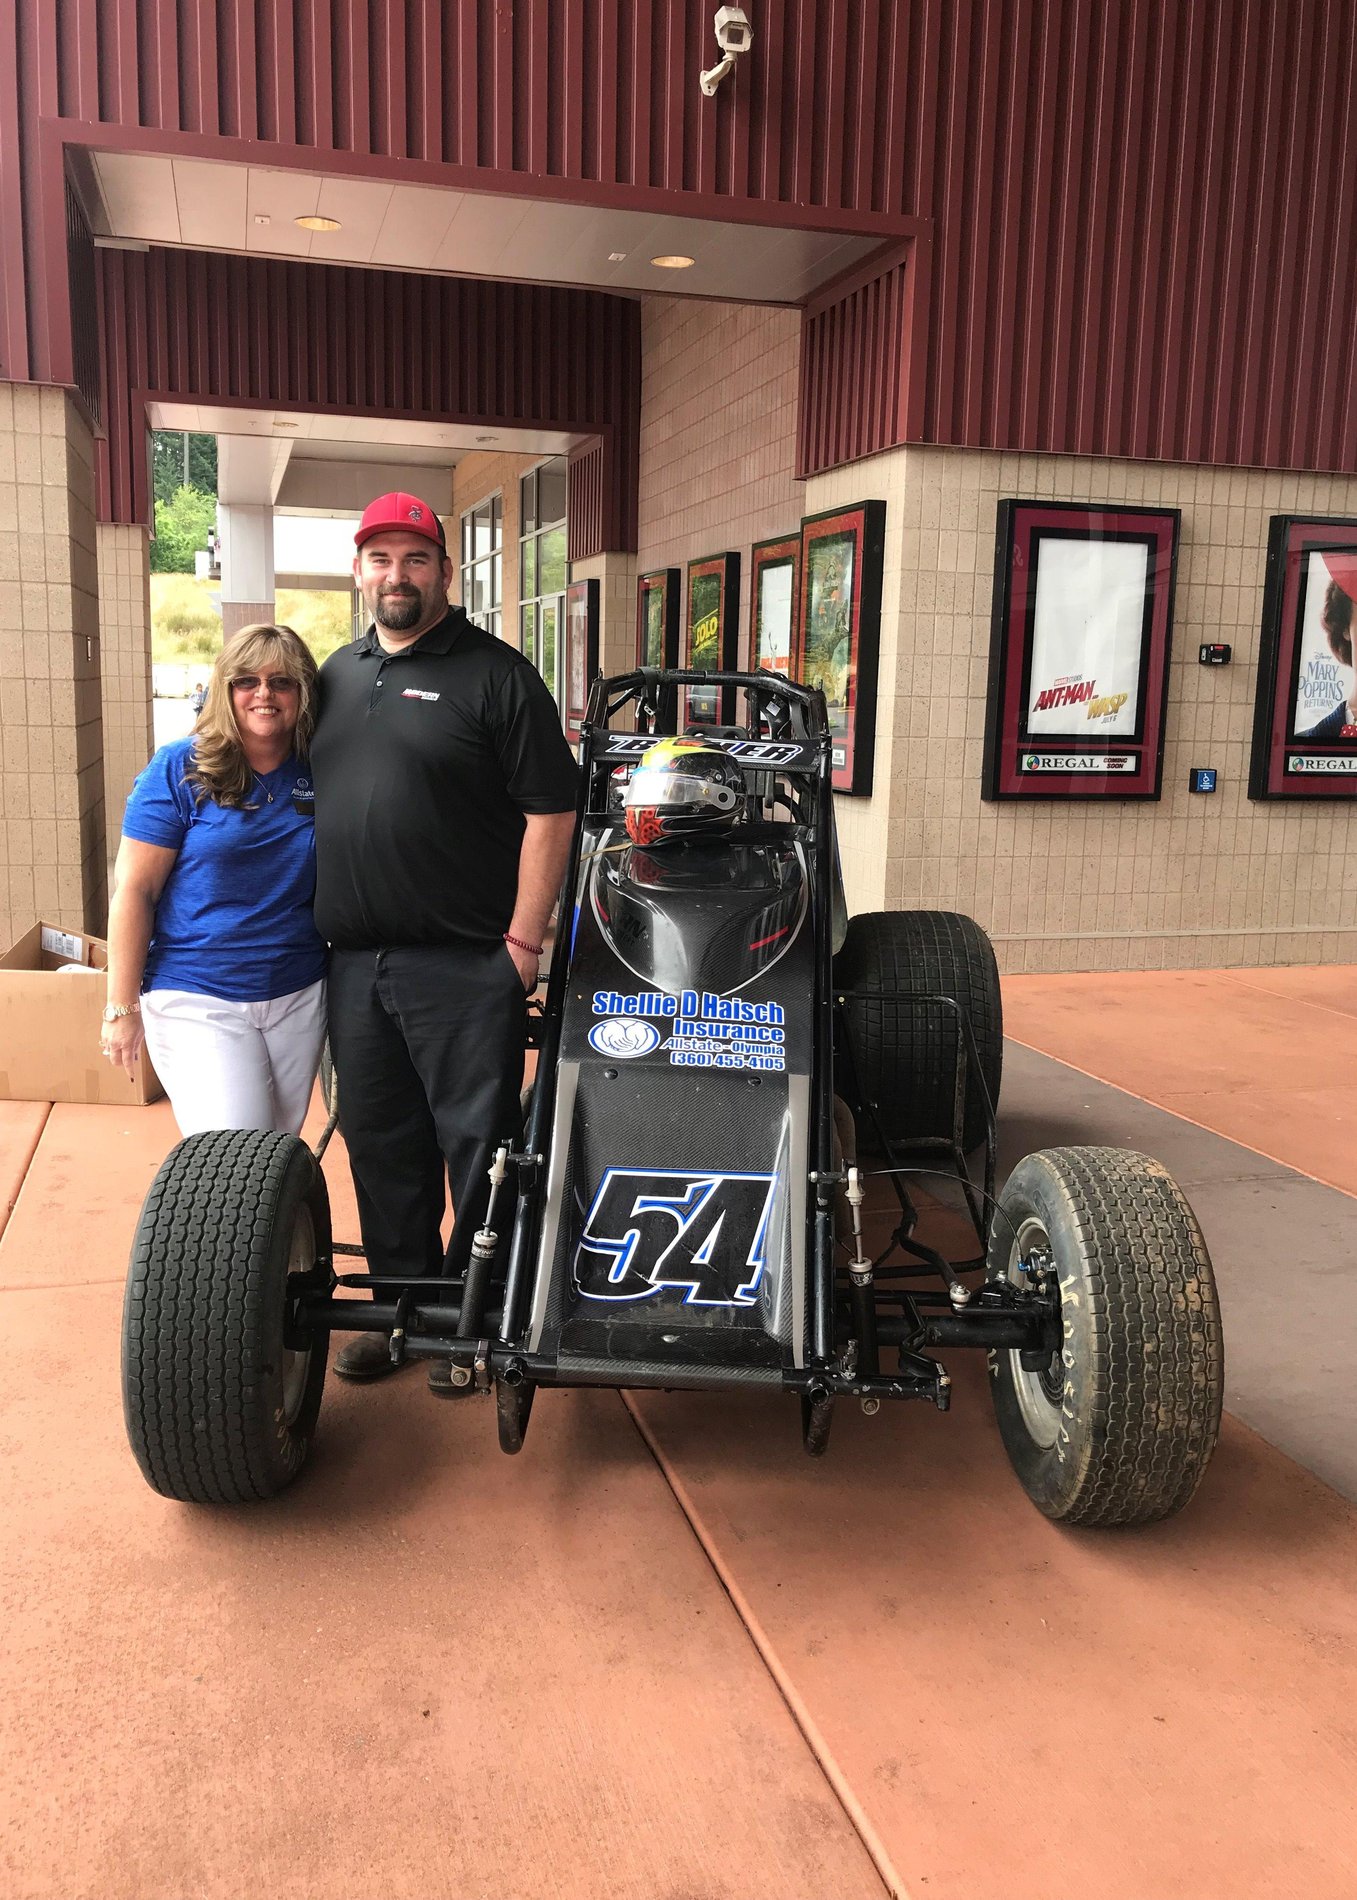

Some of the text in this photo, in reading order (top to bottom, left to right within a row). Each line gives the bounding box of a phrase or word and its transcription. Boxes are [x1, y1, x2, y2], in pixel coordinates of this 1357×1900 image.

[696, 616, 718, 646] SOLO
[1307, 661, 1339, 682] MARY
[1032, 680, 1096, 713] ANT-MAN
[1298, 676, 1344, 701] POPPINS
[1087, 692, 1128, 720] WASP
[1304, 699, 1334, 709] RETURNS
[1041, 758, 1100, 768] REGAL
[1305, 759, 1357, 770] REGAL
[592, 989, 785, 1026] Shellie D Haisch
[673, 1018, 785, 1043] Insurance
[659, 1037, 723, 1052] Allstate
[731, 1041, 785, 1056] Olympia
[670, 1051, 785, 1071] (360) 455-4105
[573, 1166, 779, 1307] 54
